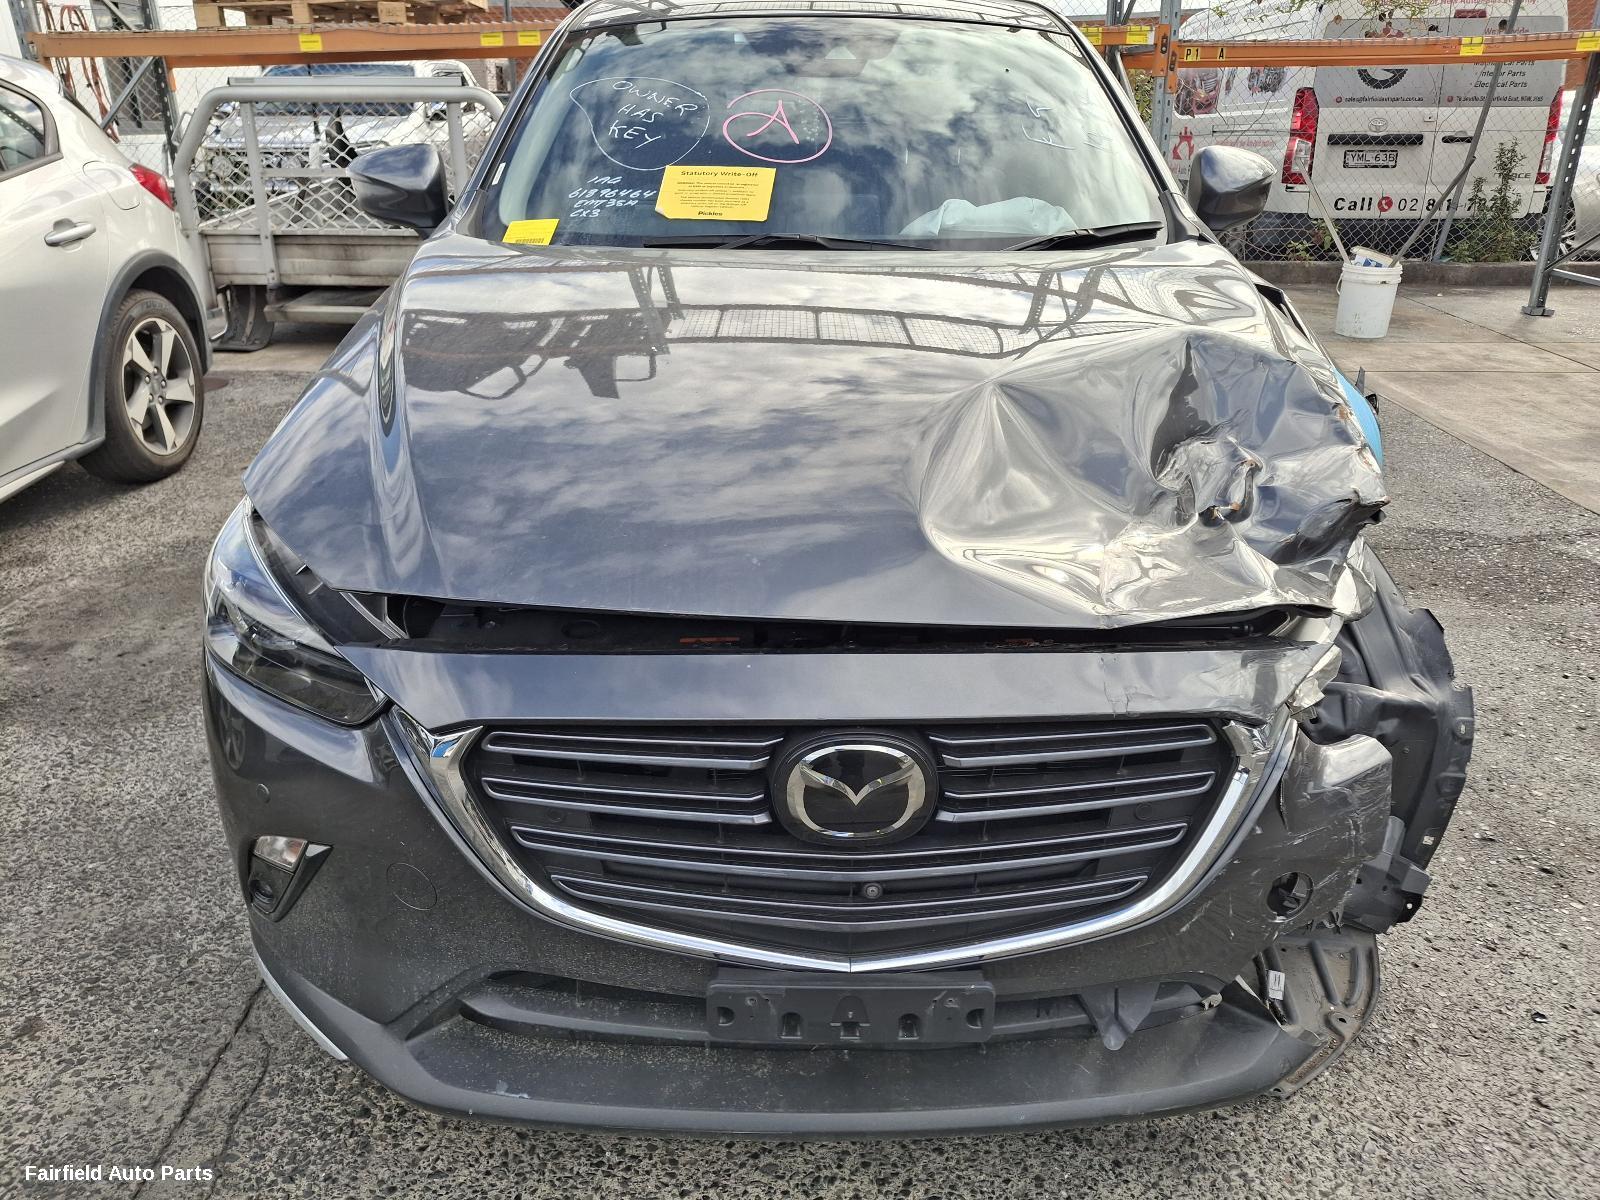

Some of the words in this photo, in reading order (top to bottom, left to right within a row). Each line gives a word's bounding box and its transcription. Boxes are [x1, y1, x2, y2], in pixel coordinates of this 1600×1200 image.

[1218, 48, 1224, 60] A
[613, 81, 698, 116] OWNER
[617, 103, 664, 123] HAS
[746, 98, 800, 145] A
[608, 120, 662, 149] KEY
[1333, 197, 1373, 211] Call
[1397, 198, 1419, 211] 02
